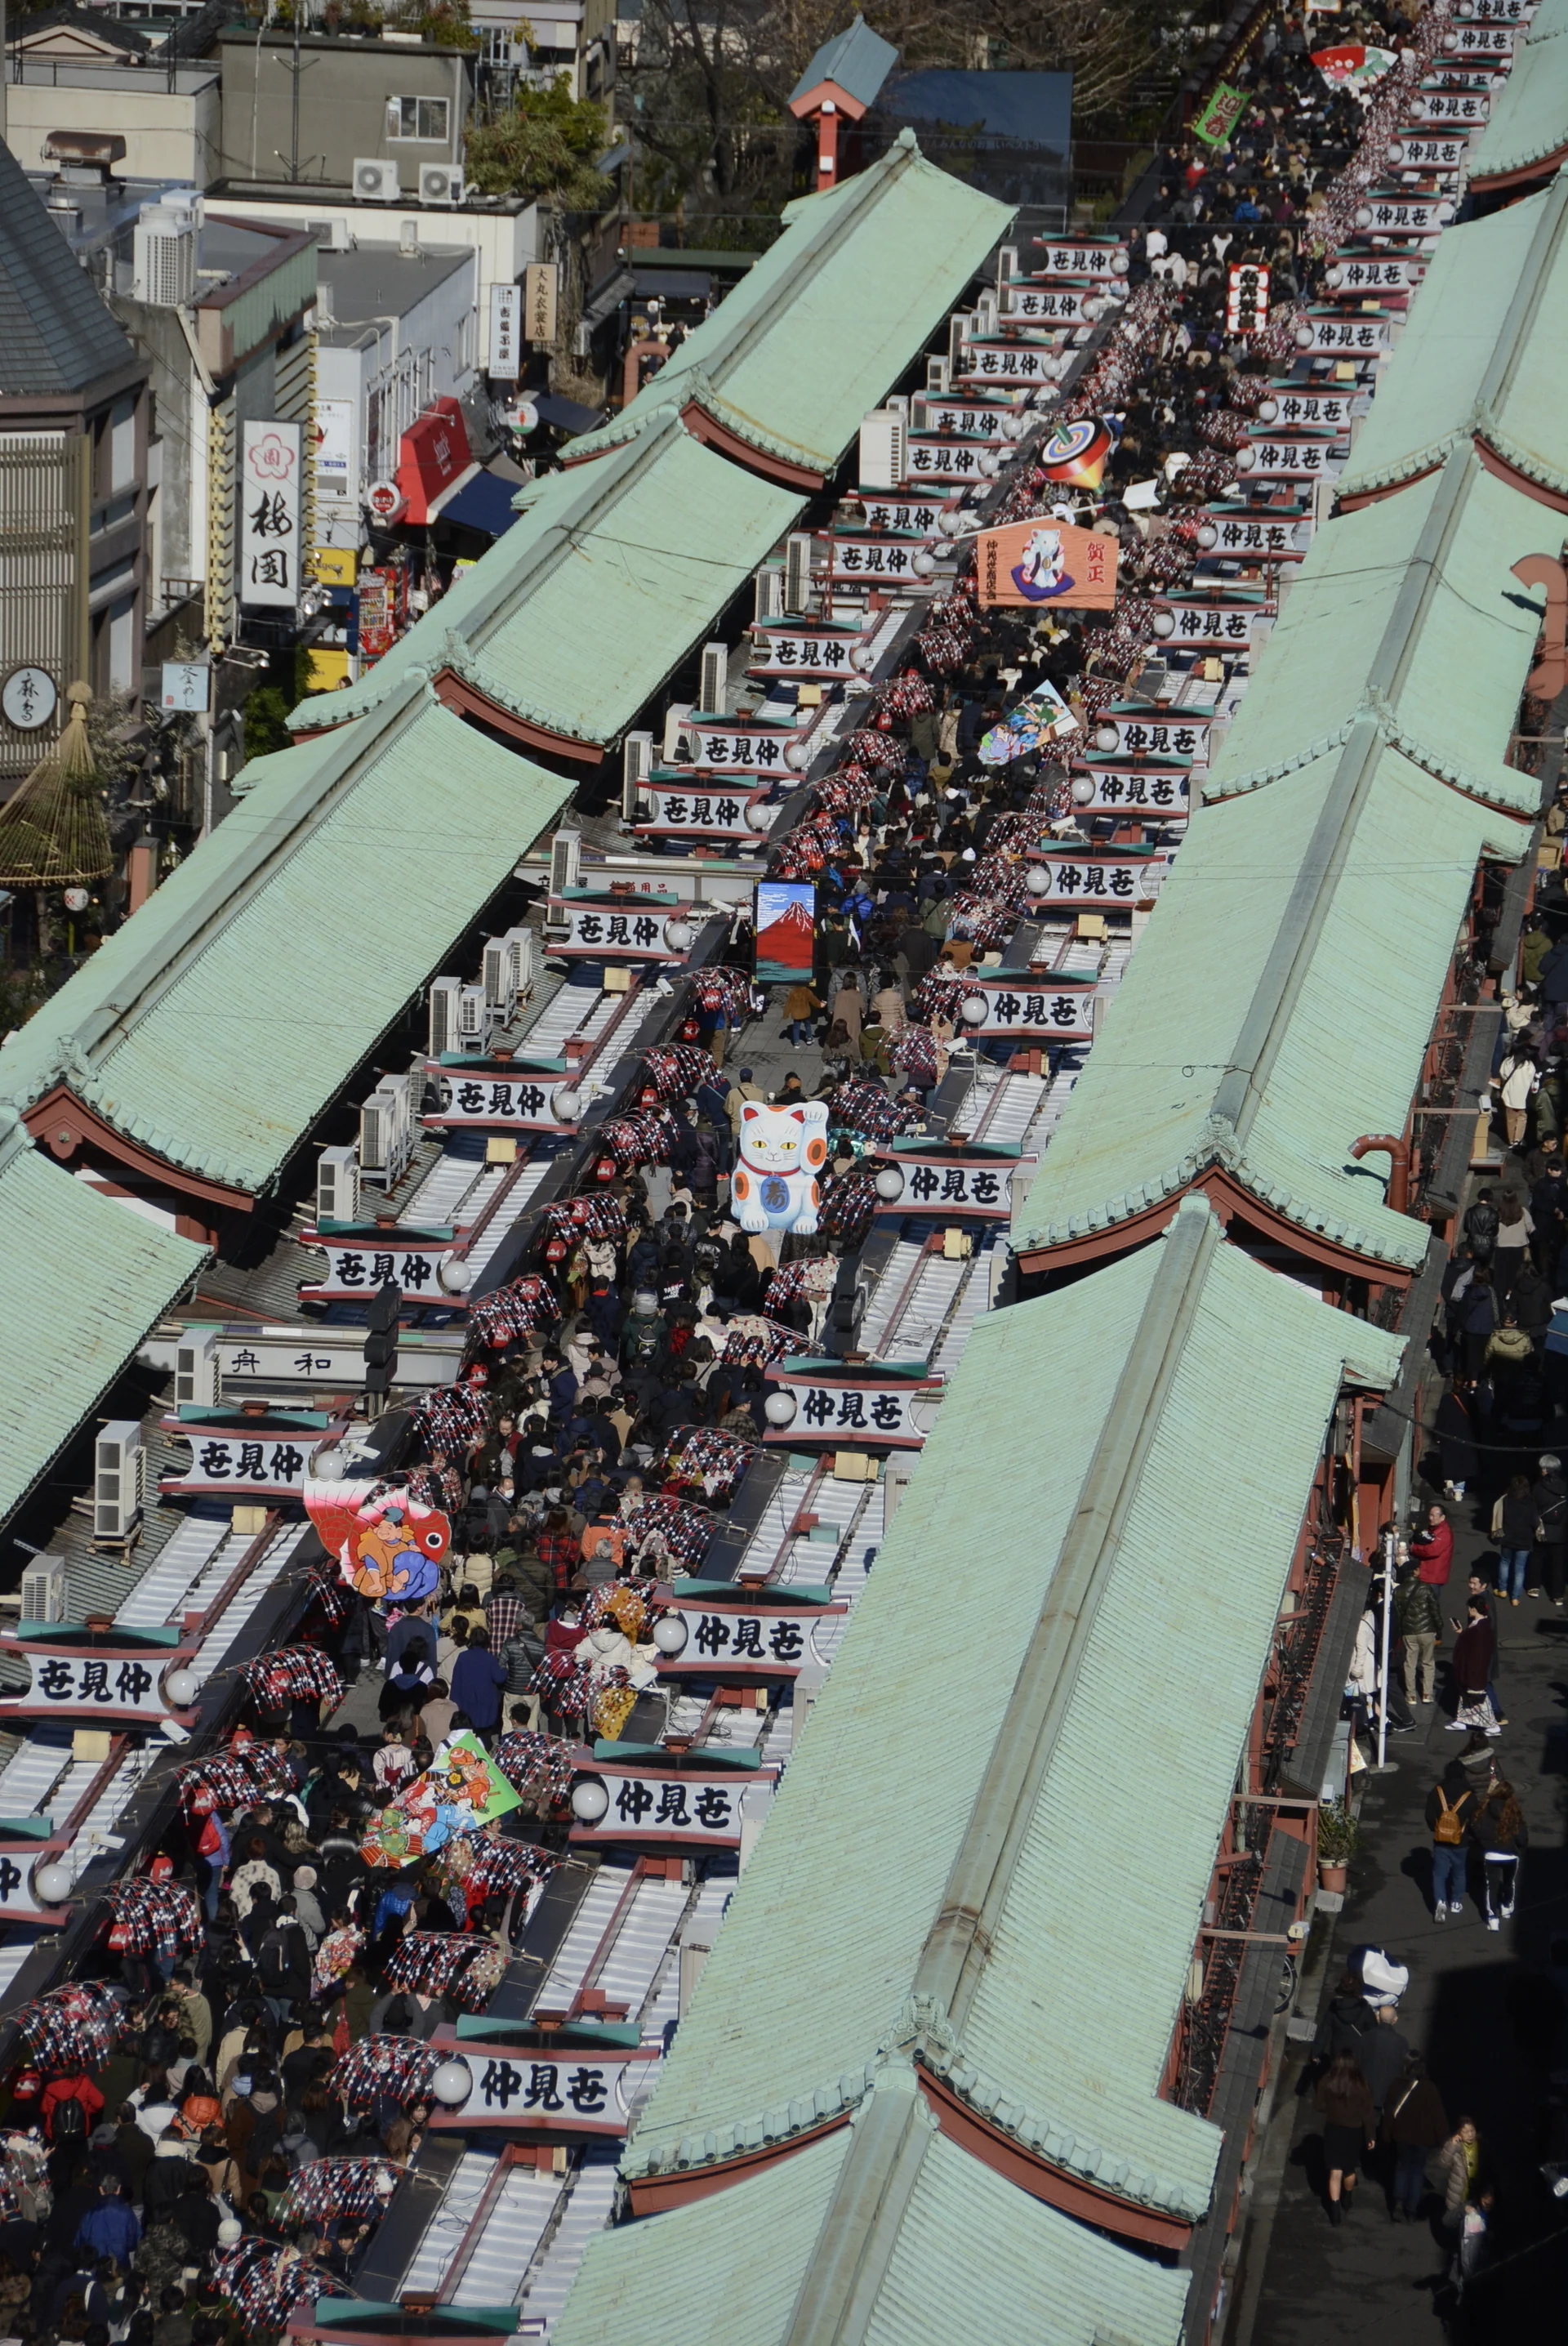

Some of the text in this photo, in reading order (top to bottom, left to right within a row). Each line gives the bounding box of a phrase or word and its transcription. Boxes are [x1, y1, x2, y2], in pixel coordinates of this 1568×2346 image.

[1477, 1, 1521, 16] 仲見世
[1461, 30, 1507, 50] 仲見世
[1205, 91, 1245, 139] 迎春
[1428, 96, 1477, 118] 仲見世
[1407, 142, 1457, 162] 仲見世
[1376, 205, 1428, 227] 仲見世
[1347, 264, 1401, 286] 仲見世
[1317, 324, 1374, 347] 仲見世
[1282, 398, 1342, 422] 仲見世
[1259, 444, 1321, 470] 仲見世
[250, 490, 292, 589] 梅園
[1222, 521, 1289, 551] 仲見世
[986, 539, 998, 600] 仲見世商店会
[1086, 541, 1106, 583] 賀正
[1179, 609, 1247, 639] 仲見世
[180, 667, 198, 708] 釜めし
[1125, 724, 1196, 754] 仲見世
[1099, 775, 1175, 805] 仲見世
[1056, 864, 1134, 897] 仲見世
[993, 992, 1077, 1027] 仲見世
[909, 1166, 1000, 1204] 仲見世
[231, 1348, 332, 1376] 舟和
[802, 1388, 903, 1430] 仲見世
[694, 1614, 804, 1661] 仲見世
[615, 1777, 734, 1829] 仲見世
[479, 2058, 608, 2113] 仲見世
